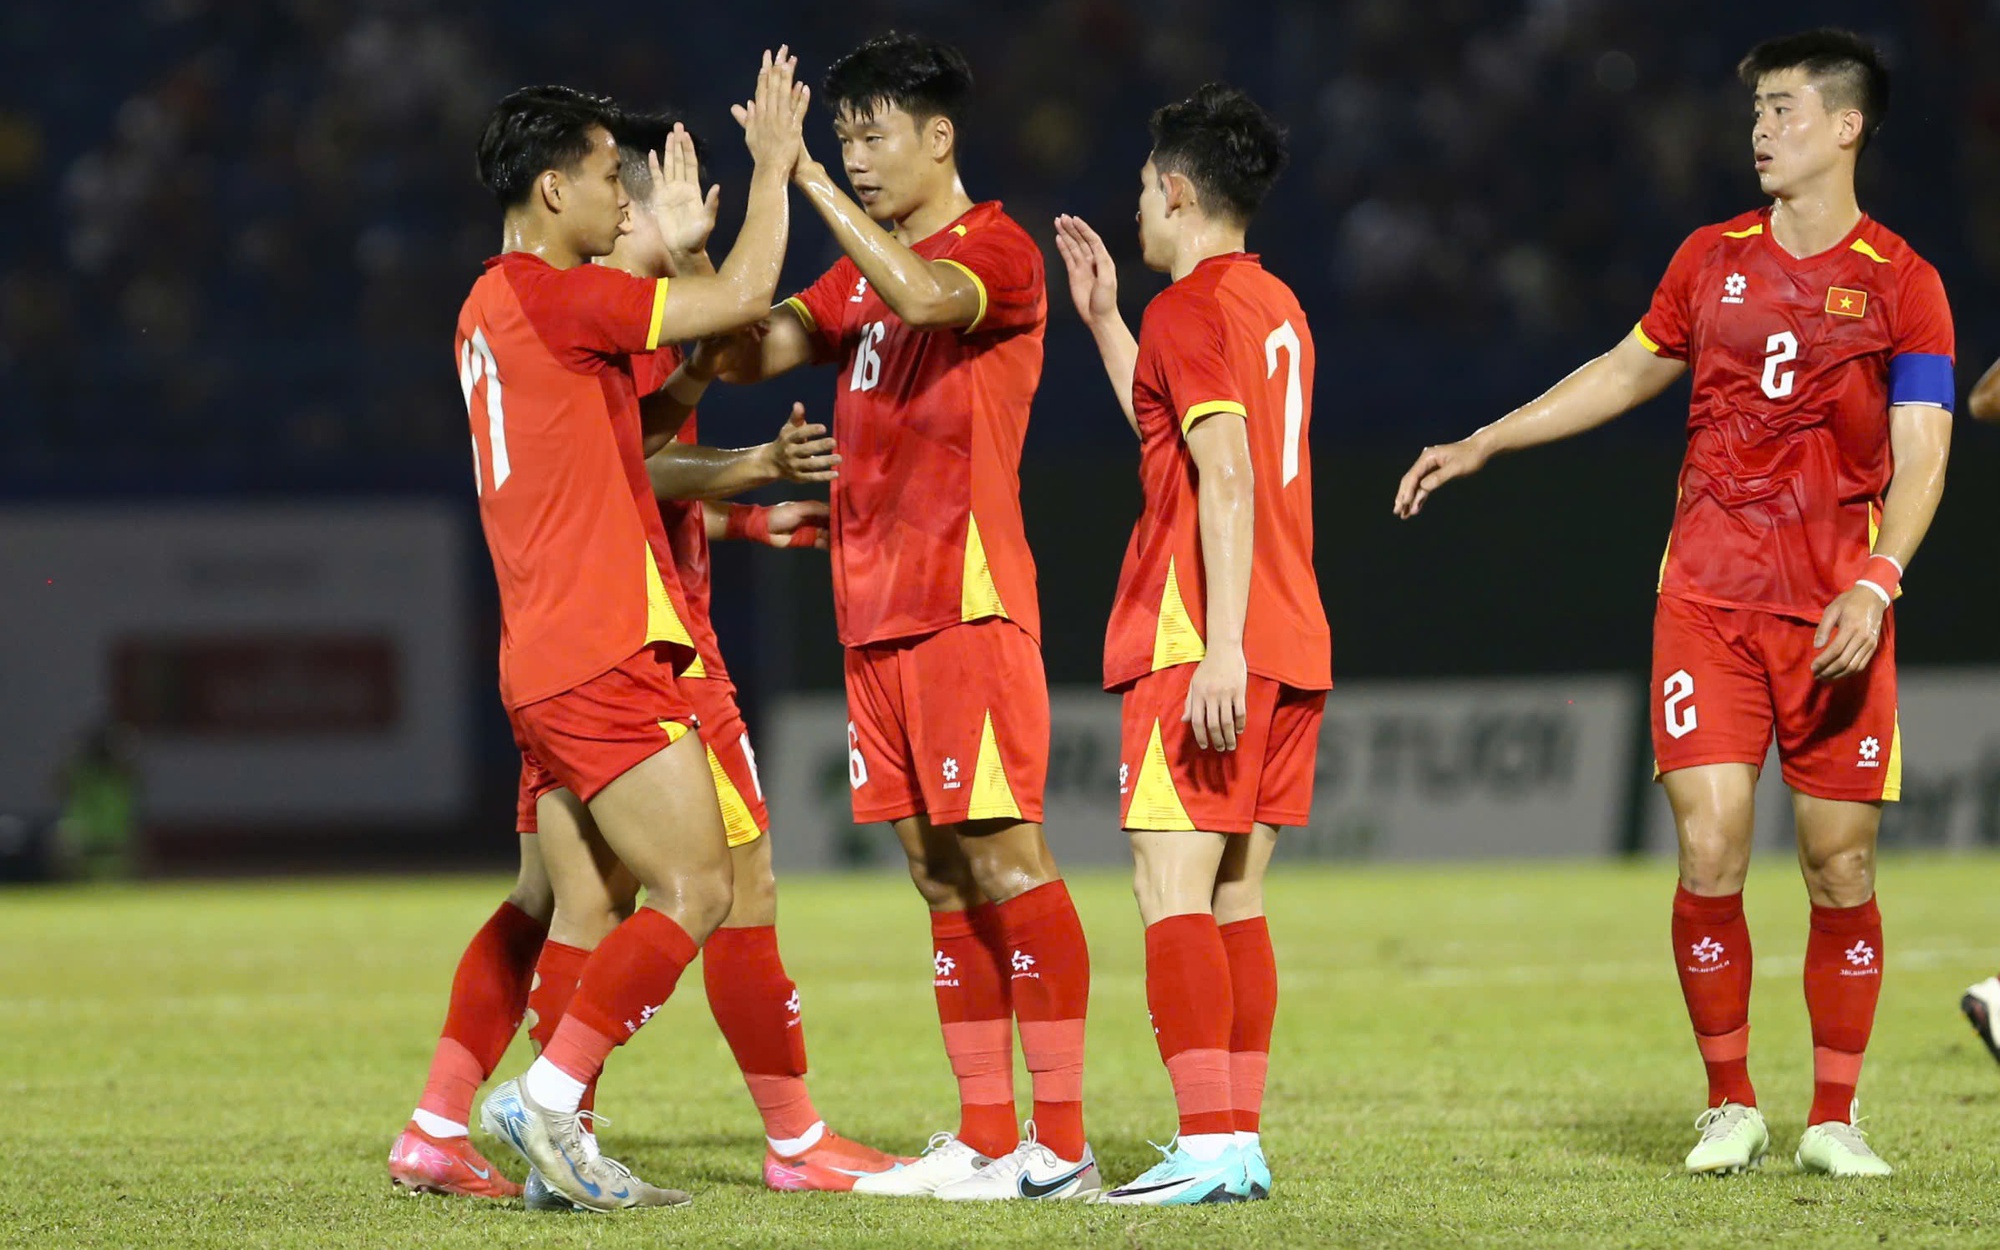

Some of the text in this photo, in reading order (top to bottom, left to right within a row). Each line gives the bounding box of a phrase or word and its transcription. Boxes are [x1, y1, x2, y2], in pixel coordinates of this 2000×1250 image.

[849, 320, 886, 393] 16
[1760, 330, 1799, 400] 2
[1264, 318, 1303, 489] 7
[1663, 669, 1698, 740] 2
